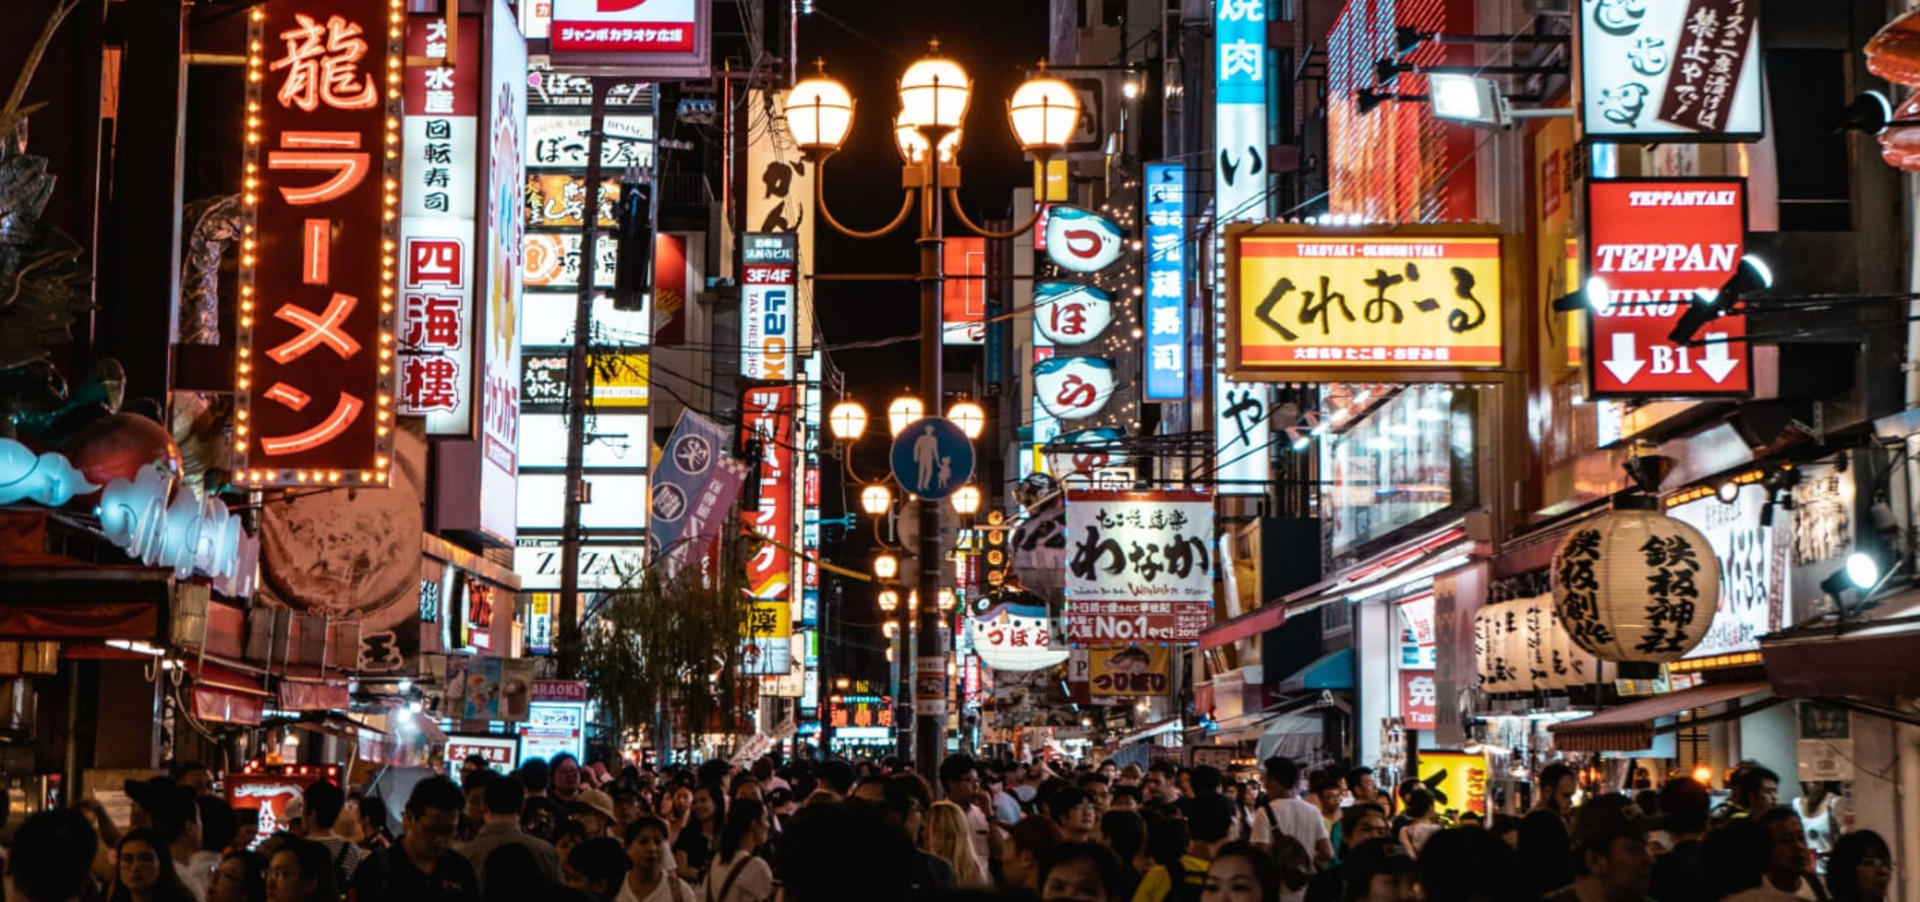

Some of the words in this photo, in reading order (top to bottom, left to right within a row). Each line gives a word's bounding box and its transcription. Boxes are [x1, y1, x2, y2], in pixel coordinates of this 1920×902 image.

[562, 28, 683, 42] ジャンボカラオケ広場
[424, 118, 451, 213] 回転寿司
[1630, 191, 1736, 206] TEPPANYAKI
[260, 14, 378, 456] 龍ラーメン
[1597, 243, 1738, 272] TEPPAN
[747, 268, 791, 283] 3F/4F
[1650, 345, 1692, 374] B1
[537, 552, 623, 575] ZZA
[1070, 525, 1210, 582] わなか
[1634, 534, 1700, 654] 鉄板神社
[1096, 615, 1147, 638] No.1
